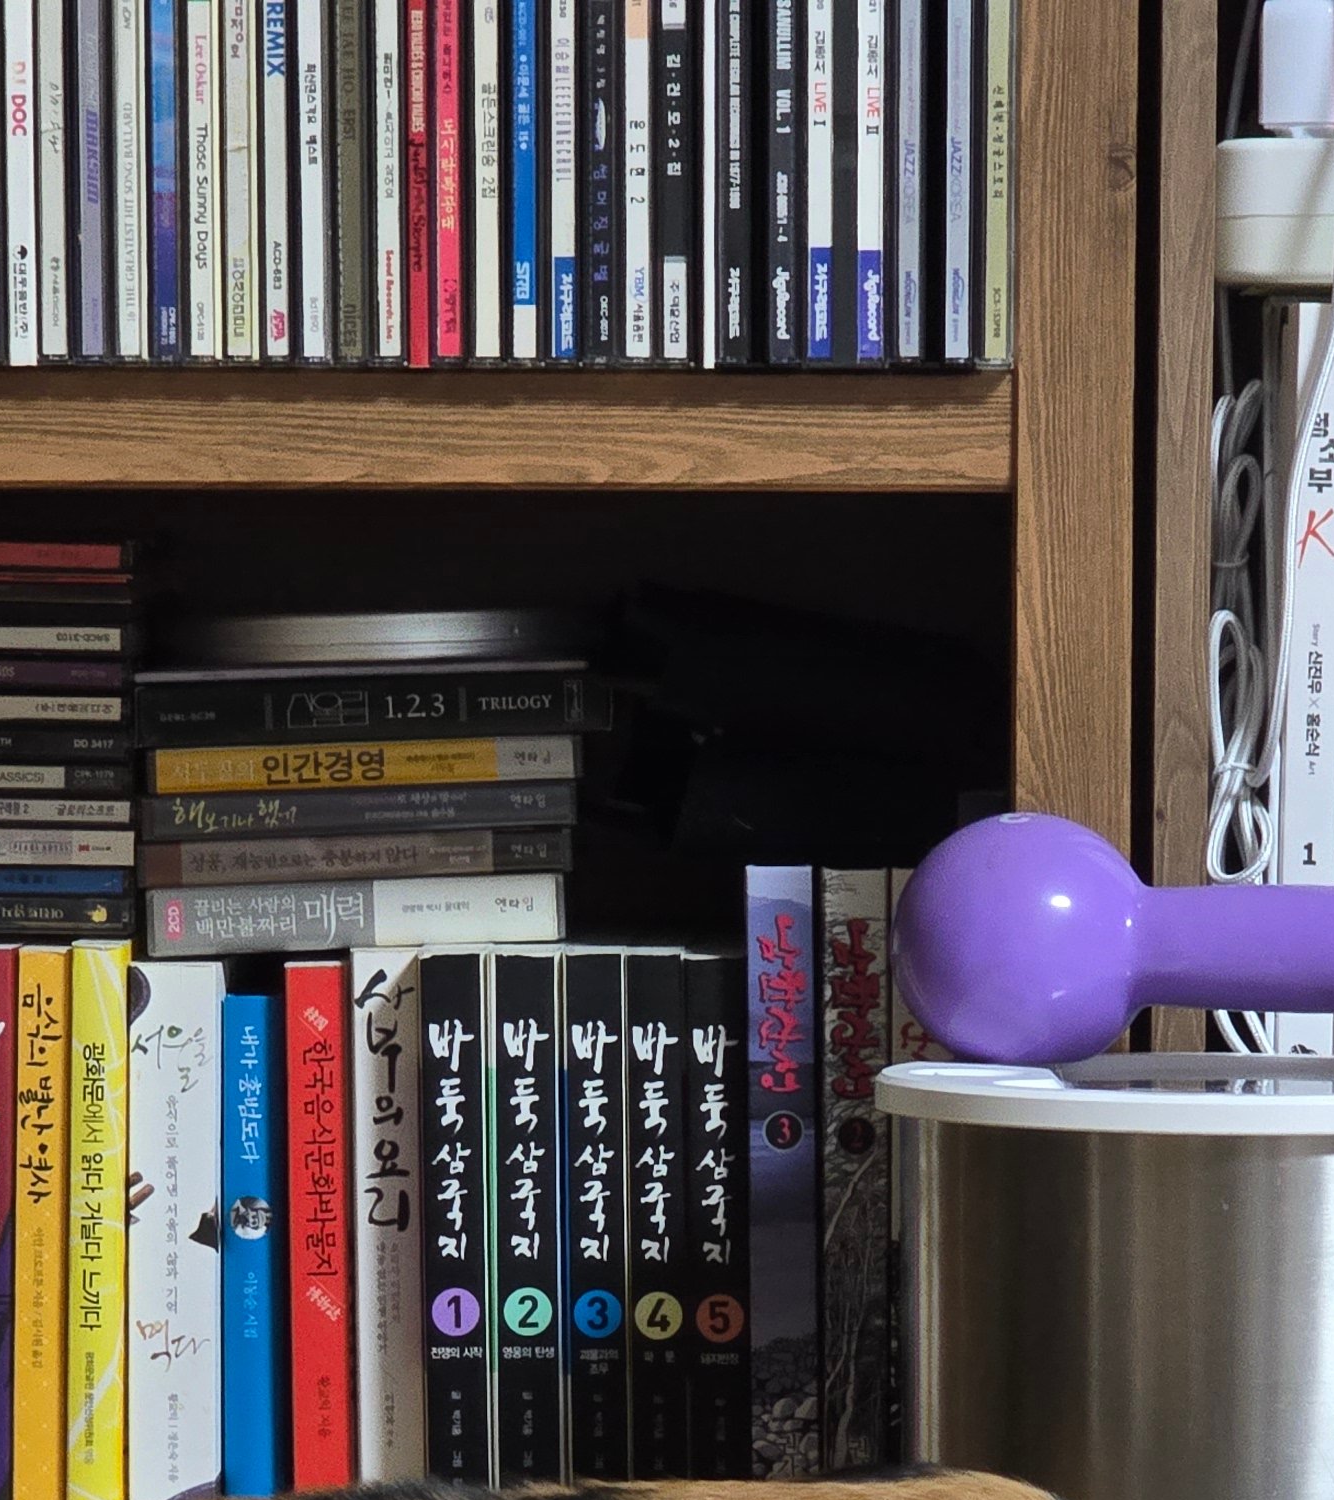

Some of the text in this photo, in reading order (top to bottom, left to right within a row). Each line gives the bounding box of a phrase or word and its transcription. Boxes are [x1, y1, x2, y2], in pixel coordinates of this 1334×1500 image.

[266, 2, 285, 78] REMIX
[12, 95, 27, 136] DOC
[814, 81, 827, 113] LIVE
[480, 82, 497, 168] 골든스크린송
[193, 34, 210, 270] Lee Oskar Those Sunny Days
[384, 692, 554, 721] 1.2.3 TRILOGY
[261, 747, 387, 786] 인간경영
[1302, 842, 1317, 866] 1
[304, 887, 366, 944] 매력
[755, 911, 810, 1094] 남한산성
[18, 982, 64, 1131] 음식의 별난
[352, 967, 415, 1128] 사부의
[77, 1042, 106, 1332] 광화문에서 읽다 거닐다 느끼다
[361, 1138, 413, 1234] 요리
[446, 1294, 463, 1330] 1
[516, 1295, 541, 1330] 2
[586, 1296, 607, 1332] 3
[644, 1297, 672, 1333] 4
[708, 1299, 730, 1335] 5
